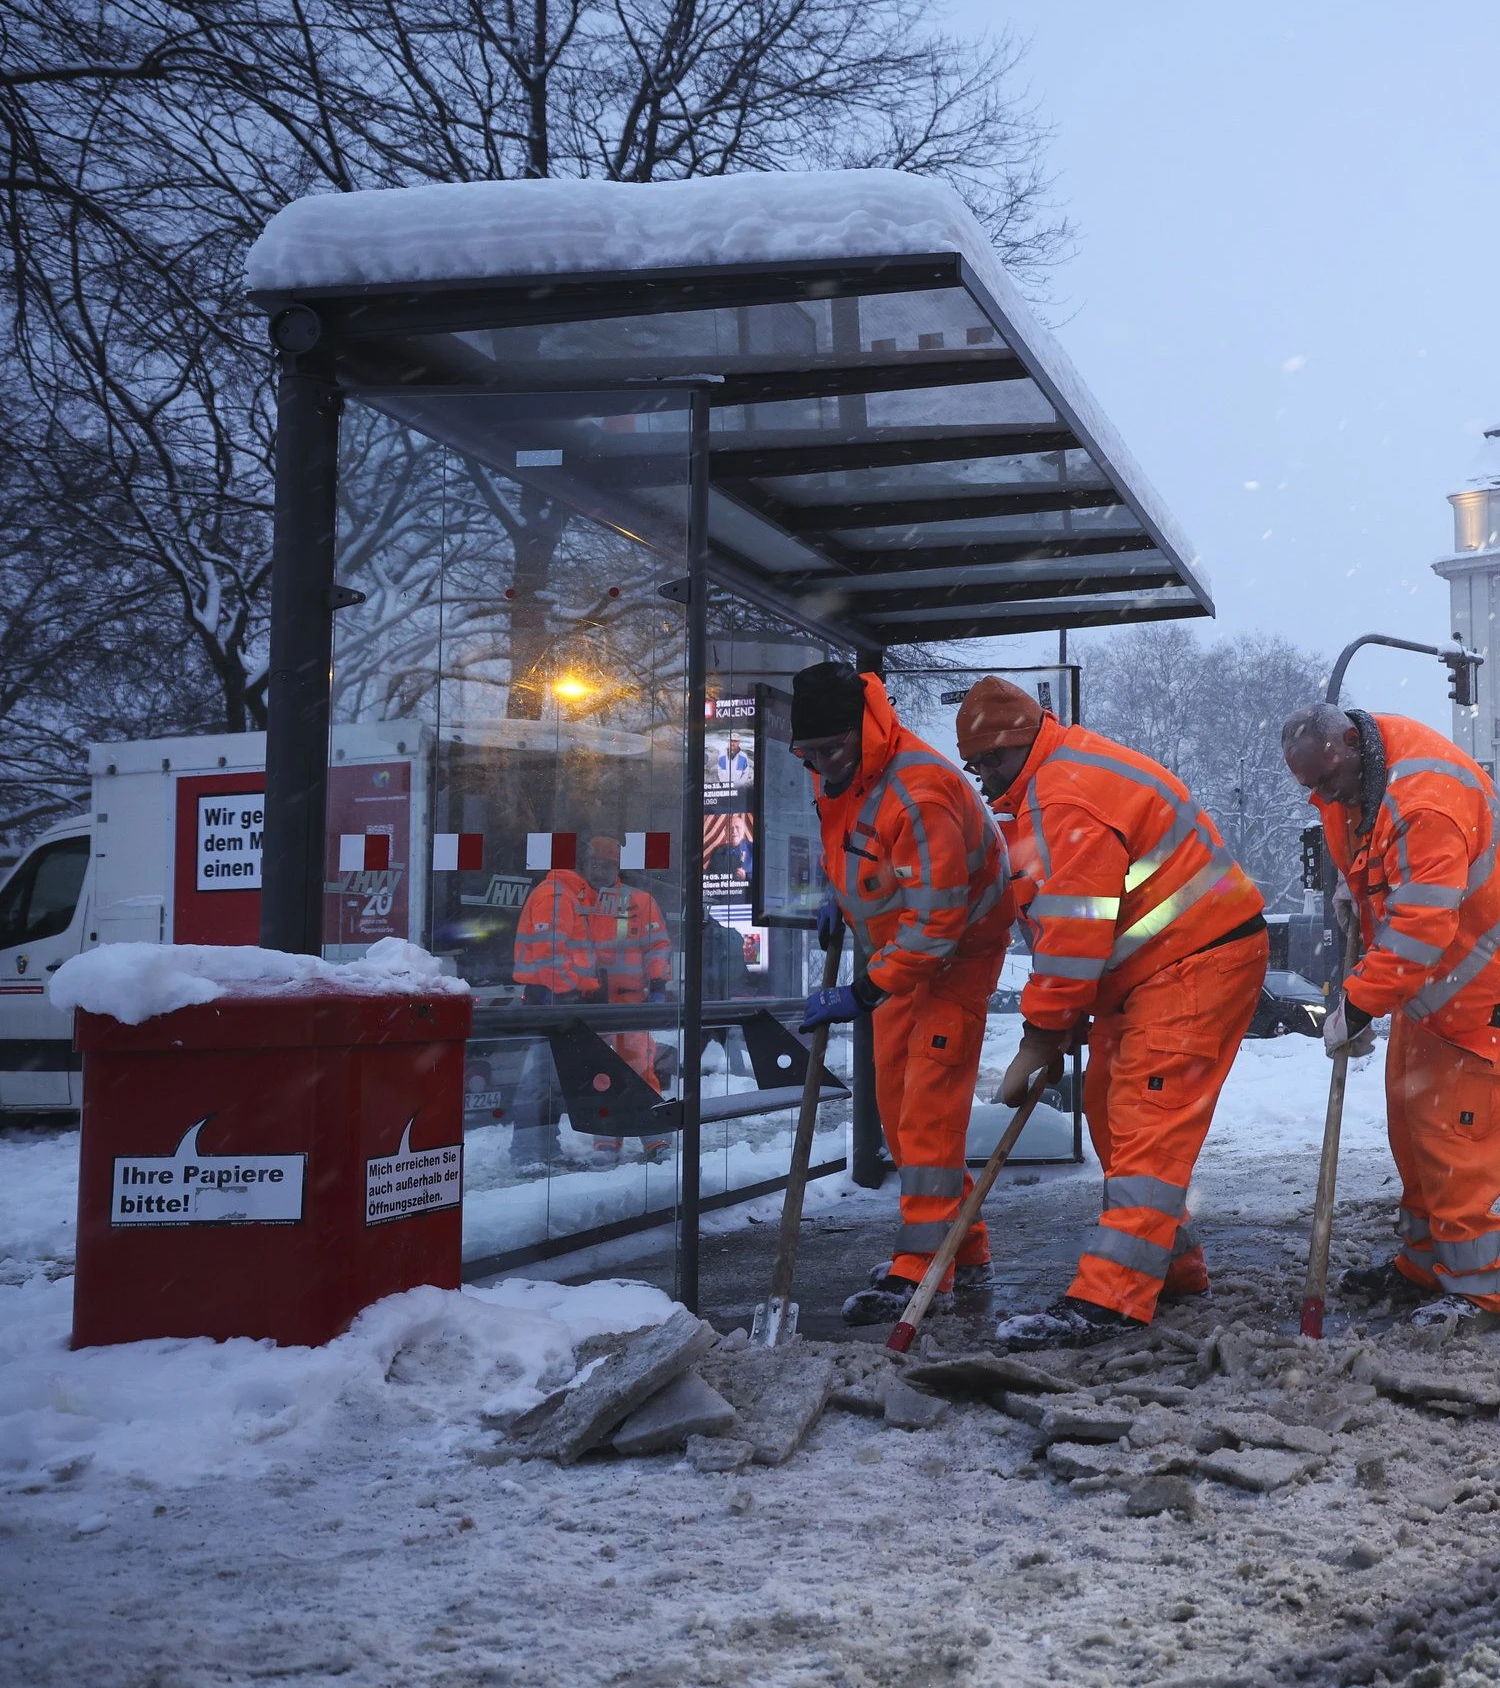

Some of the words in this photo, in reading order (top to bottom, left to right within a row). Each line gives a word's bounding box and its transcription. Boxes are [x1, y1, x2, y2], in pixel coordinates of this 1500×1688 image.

[715, 698, 756, 708] STADTKULT
[715, 706, 756, 718] KALEND
[204, 807, 236, 827] Wir
[241, 809, 263, 830] ge
[203, 833, 243, 852] dem
[249, 831, 264, 850] M
[203, 859, 254, 878] einen
[361, 886, 393, 917] 20
[369, 1162, 393, 1178] Mich
[395, 1154, 440, 1173] erreichen
[442, 1151, 457, 1164] Sie
[122, 1166, 174, 1185] Ihre
[183, 1165, 284, 1188] Papiere
[368, 1180, 393, 1198] auch
[395, 1171, 442, 1192] außerhalb
[444, 1169, 459, 1182] der
[120, 1194, 190, 1214] bitte!
[368, 1191, 443, 1217] Öffnungszeiten.
